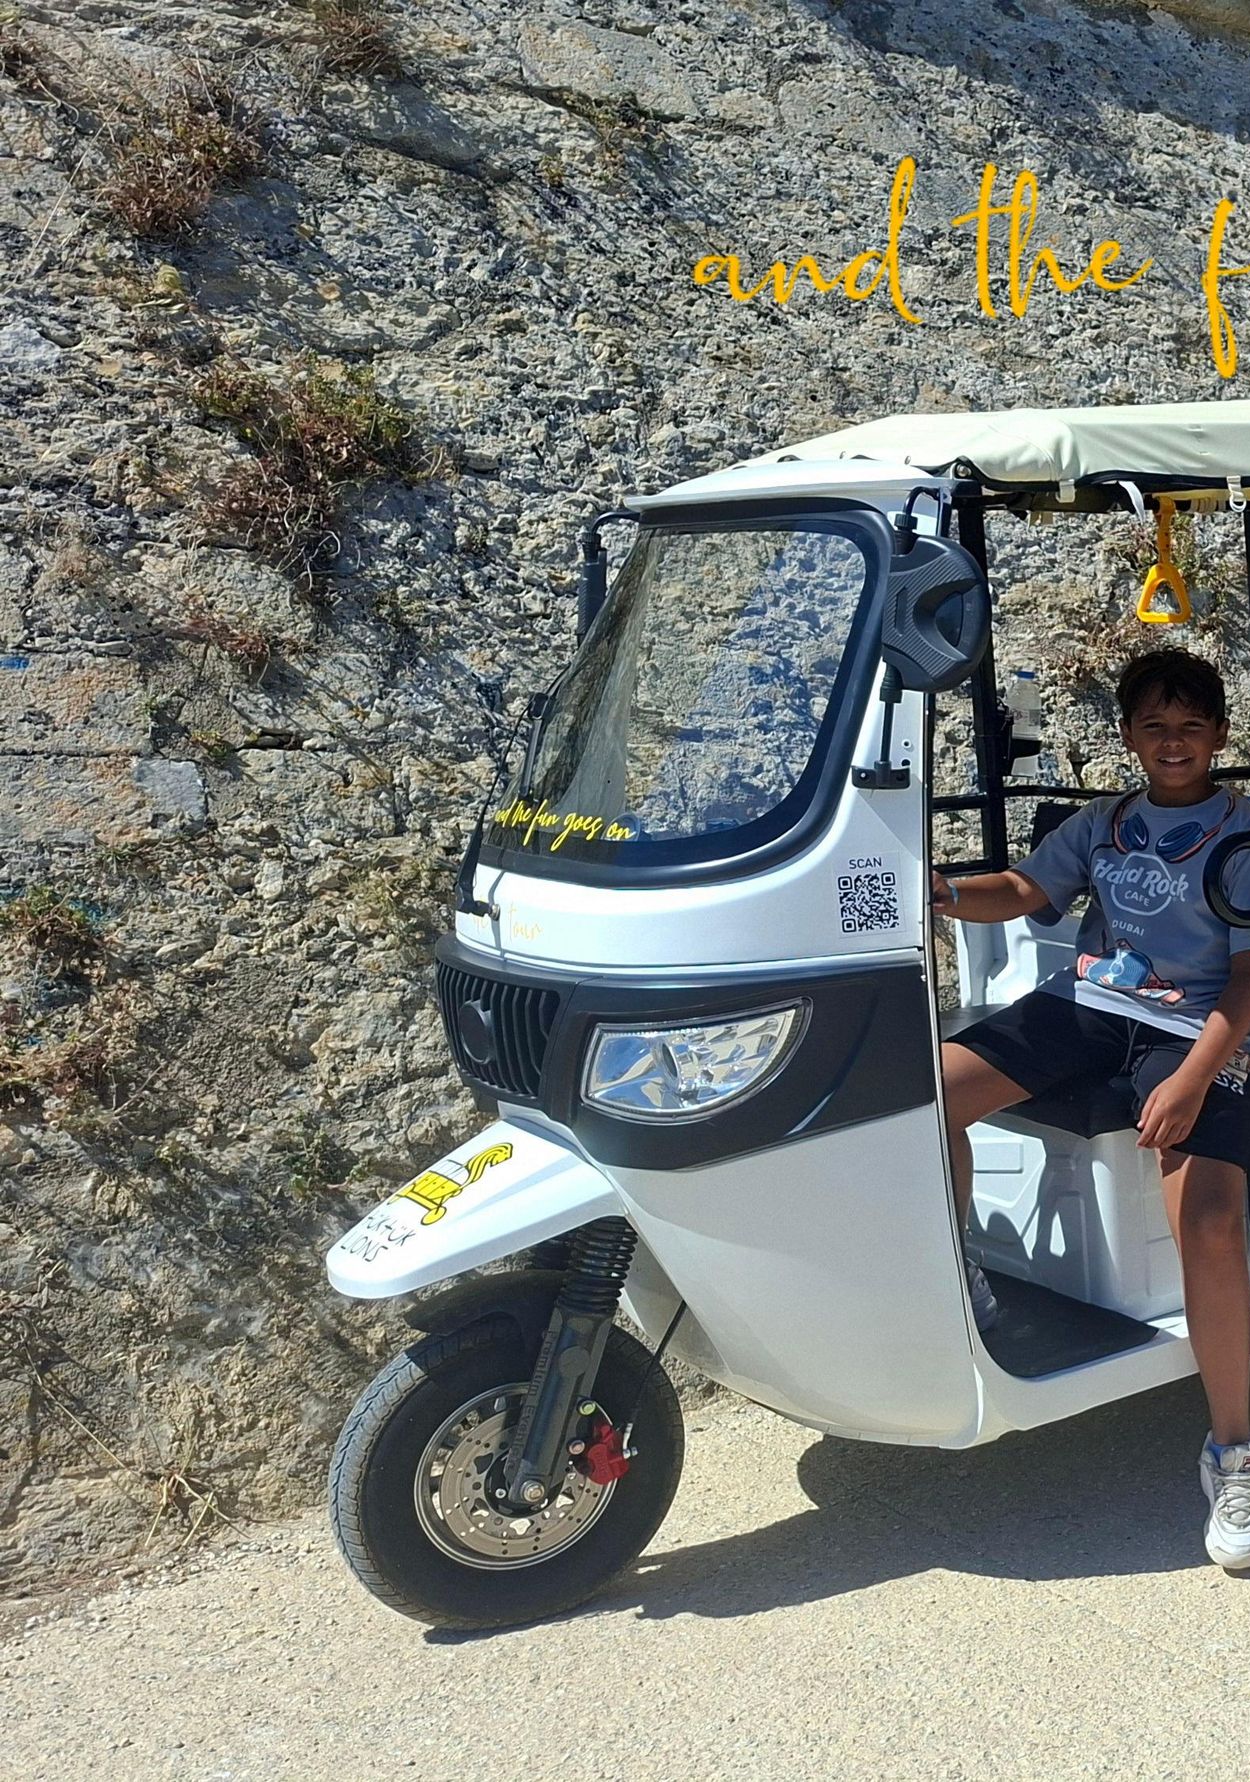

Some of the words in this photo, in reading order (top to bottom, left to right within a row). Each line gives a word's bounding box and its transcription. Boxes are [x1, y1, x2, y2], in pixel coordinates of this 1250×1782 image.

[523, 799, 561, 846] fun
[550, 812, 603, 851] goes
[606, 822, 637, 839] on
[848, 857, 882, 870] SCAN
[1094, 858, 1144, 885] Hard
[1142, 873, 1189, 902] Rock
[1124, 889, 1151, 907] CAFE
[1112, 919, 1145, 937] DUBAI
